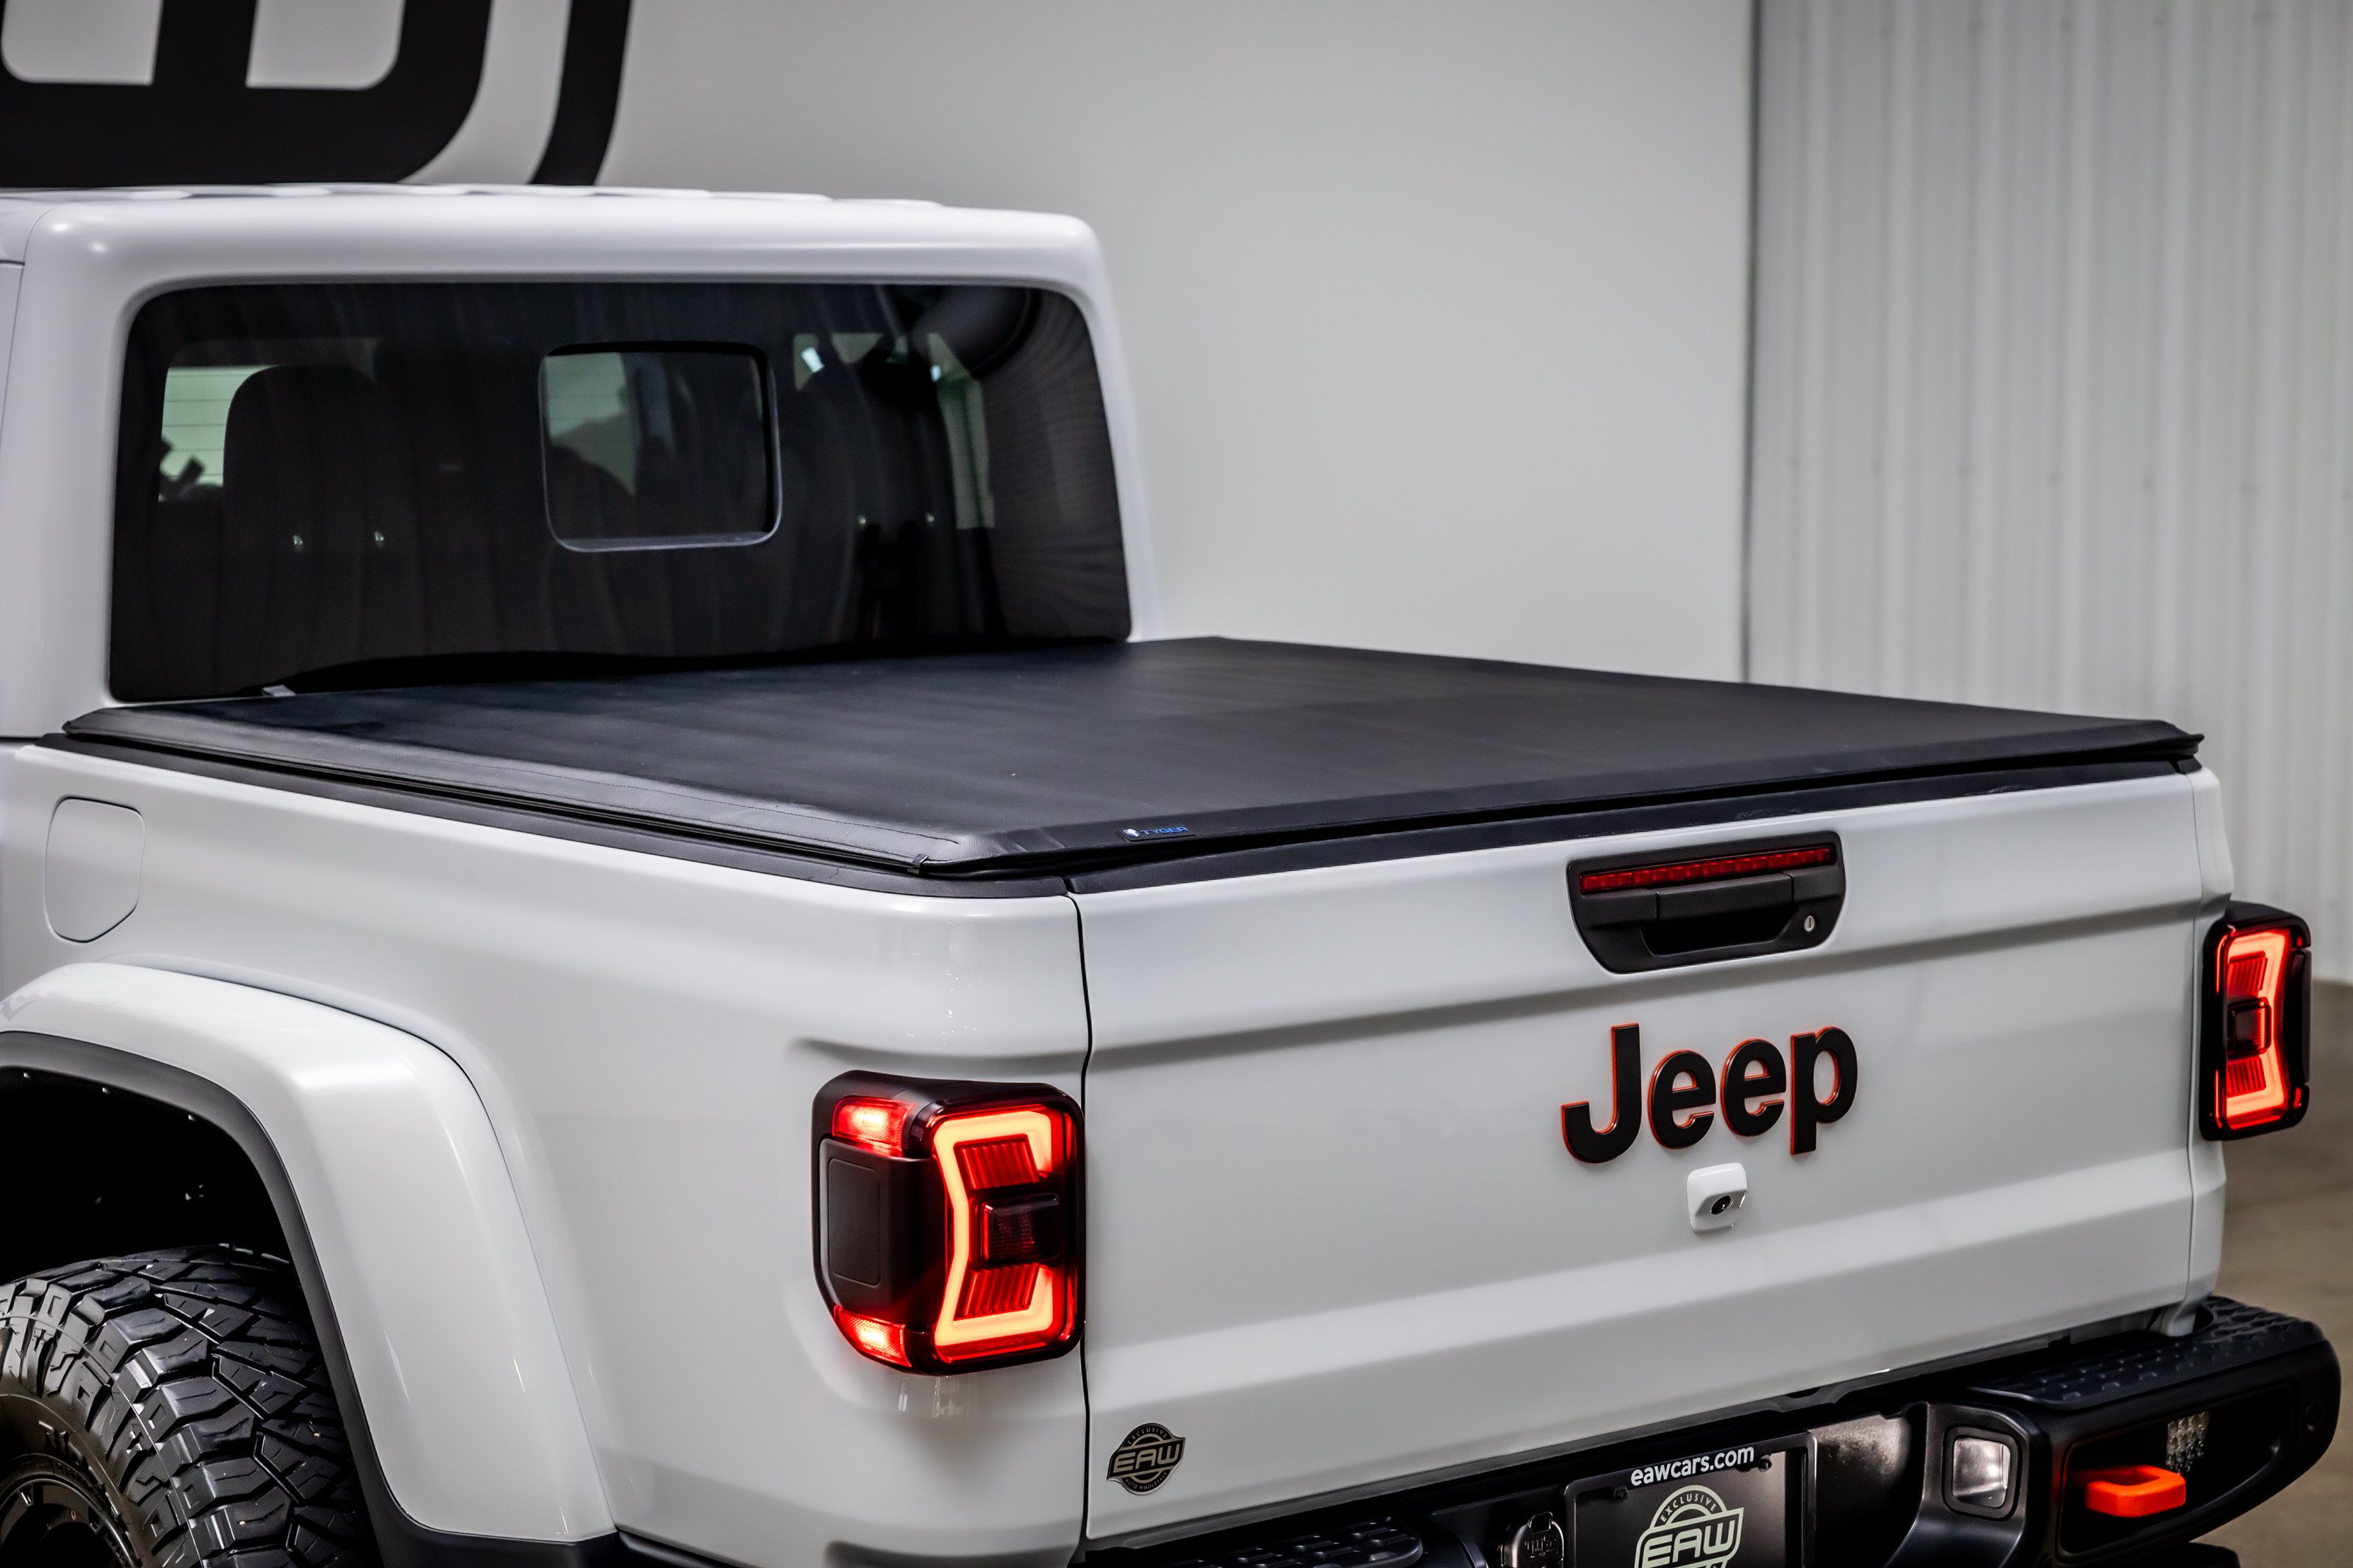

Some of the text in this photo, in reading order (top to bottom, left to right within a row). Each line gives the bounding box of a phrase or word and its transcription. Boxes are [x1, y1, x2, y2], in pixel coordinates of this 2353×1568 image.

[1140, 826, 1188, 835] TYGER
[1561, 1023, 1858, 1164] Jeep
[1113, 1444, 1180, 1473] EAW
[1630, 1446, 1754, 1486] eawcars.com
[1660, 1493, 1717, 1522] EXCLUSIVE
[1641, 1519, 1735, 1568] EAW
